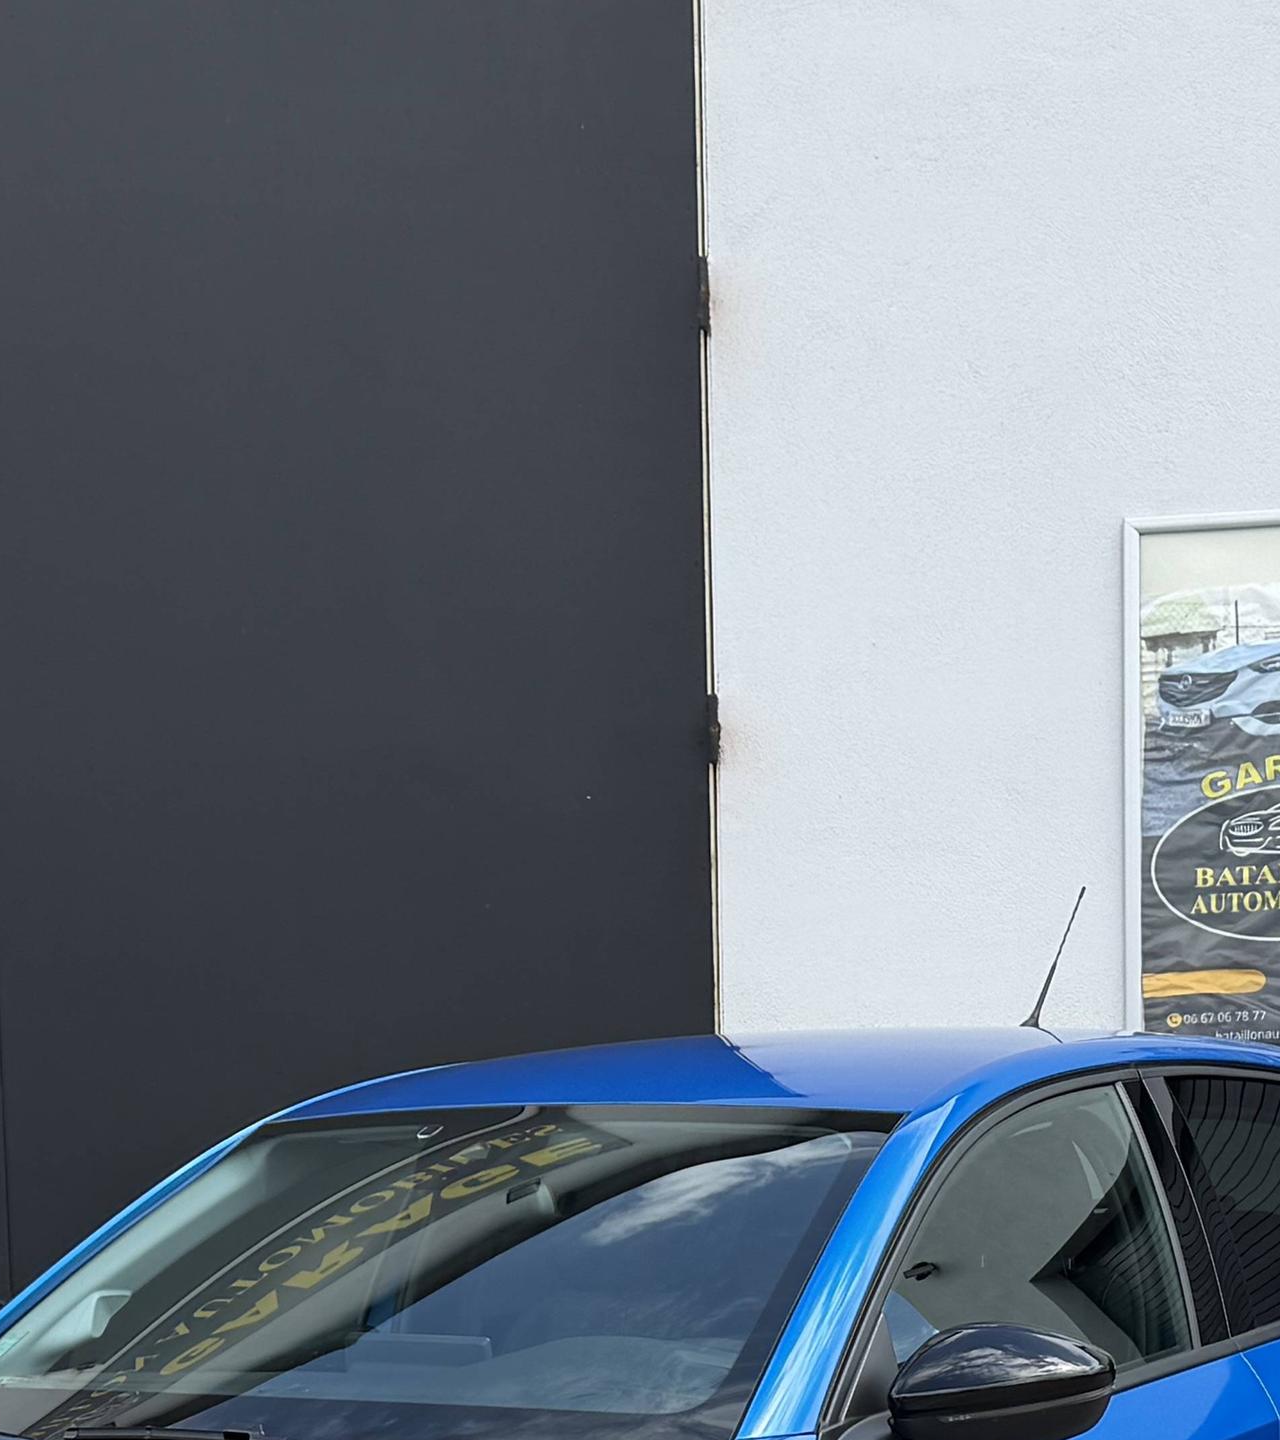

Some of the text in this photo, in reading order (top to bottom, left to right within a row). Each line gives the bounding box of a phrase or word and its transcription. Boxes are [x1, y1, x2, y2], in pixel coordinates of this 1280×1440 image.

[1183, 1010, 1267, 1024] 06 67 06 78 77
